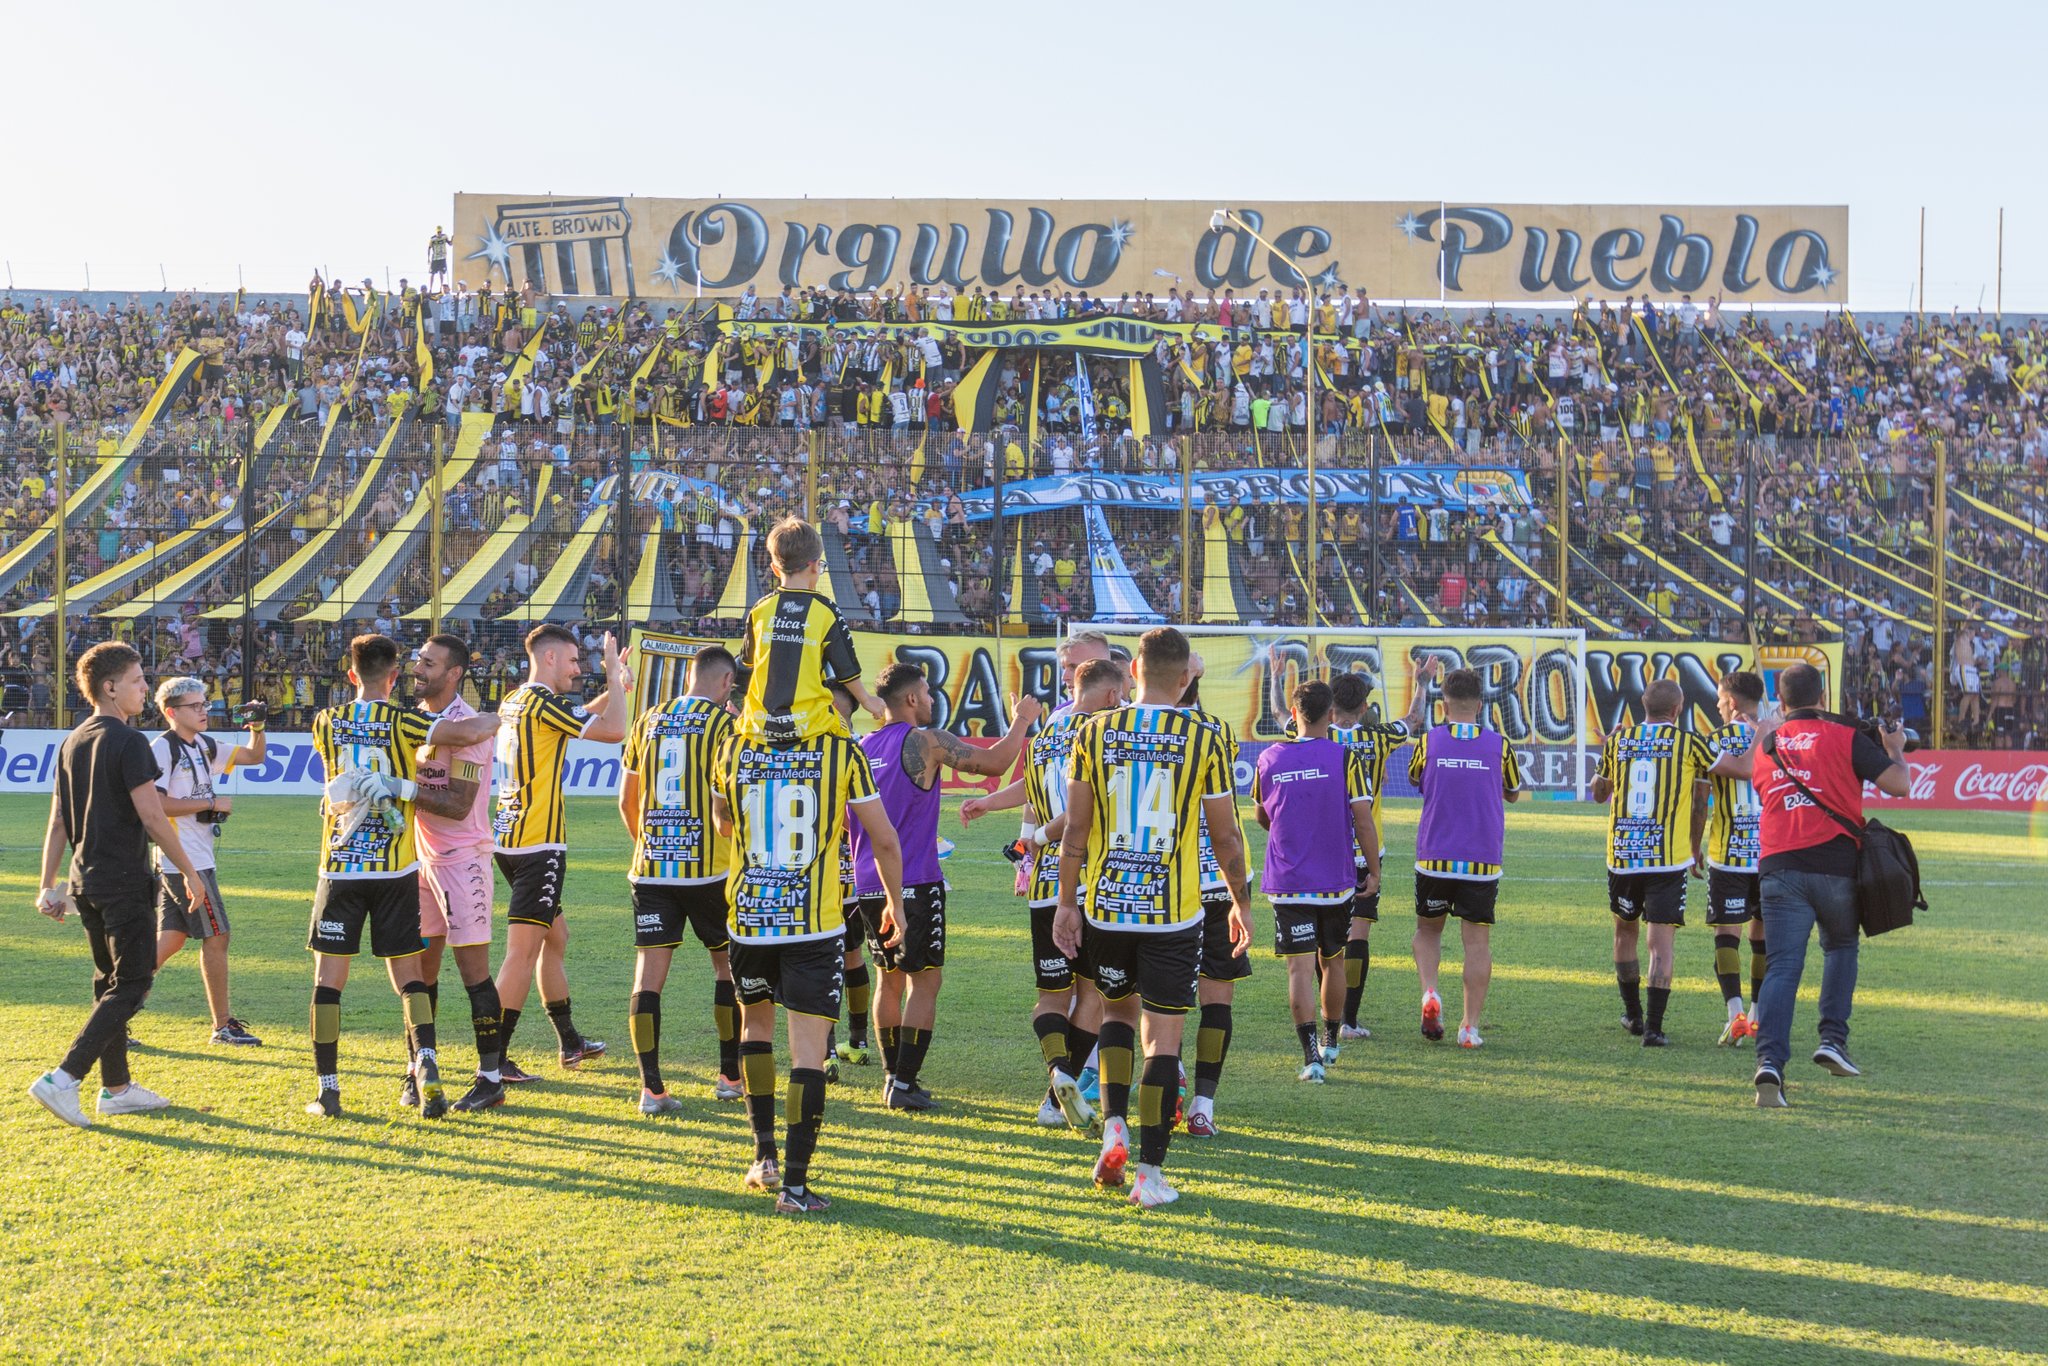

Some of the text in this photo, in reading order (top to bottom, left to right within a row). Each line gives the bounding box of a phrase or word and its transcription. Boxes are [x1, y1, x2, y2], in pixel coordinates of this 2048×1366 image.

[507, 214, 621, 238] ALTE. BROWN
[669, 203, 1829, 293] Orgullo de Pueblo
[1196, 472, 1456, 503] BROWN
[645, 639, 691, 653] ALMIRANTE
[1411, 643, 1742, 741] BROWN
[1118, 750, 1185, 764] ExtraMédica
[656, 737, 687, 805] 2
[752, 767, 821, 779] ExtraMédica
[1627, 760, 1657, 818] 8
[645, 818, 703, 826] POMPEYA S.A.
[1107, 766, 1176, 853] 14
[742, 784, 818, 868] 18
[1106, 860, 1152, 872] POMPEYA
[1107, 850, 1161, 862] MERCEDES
